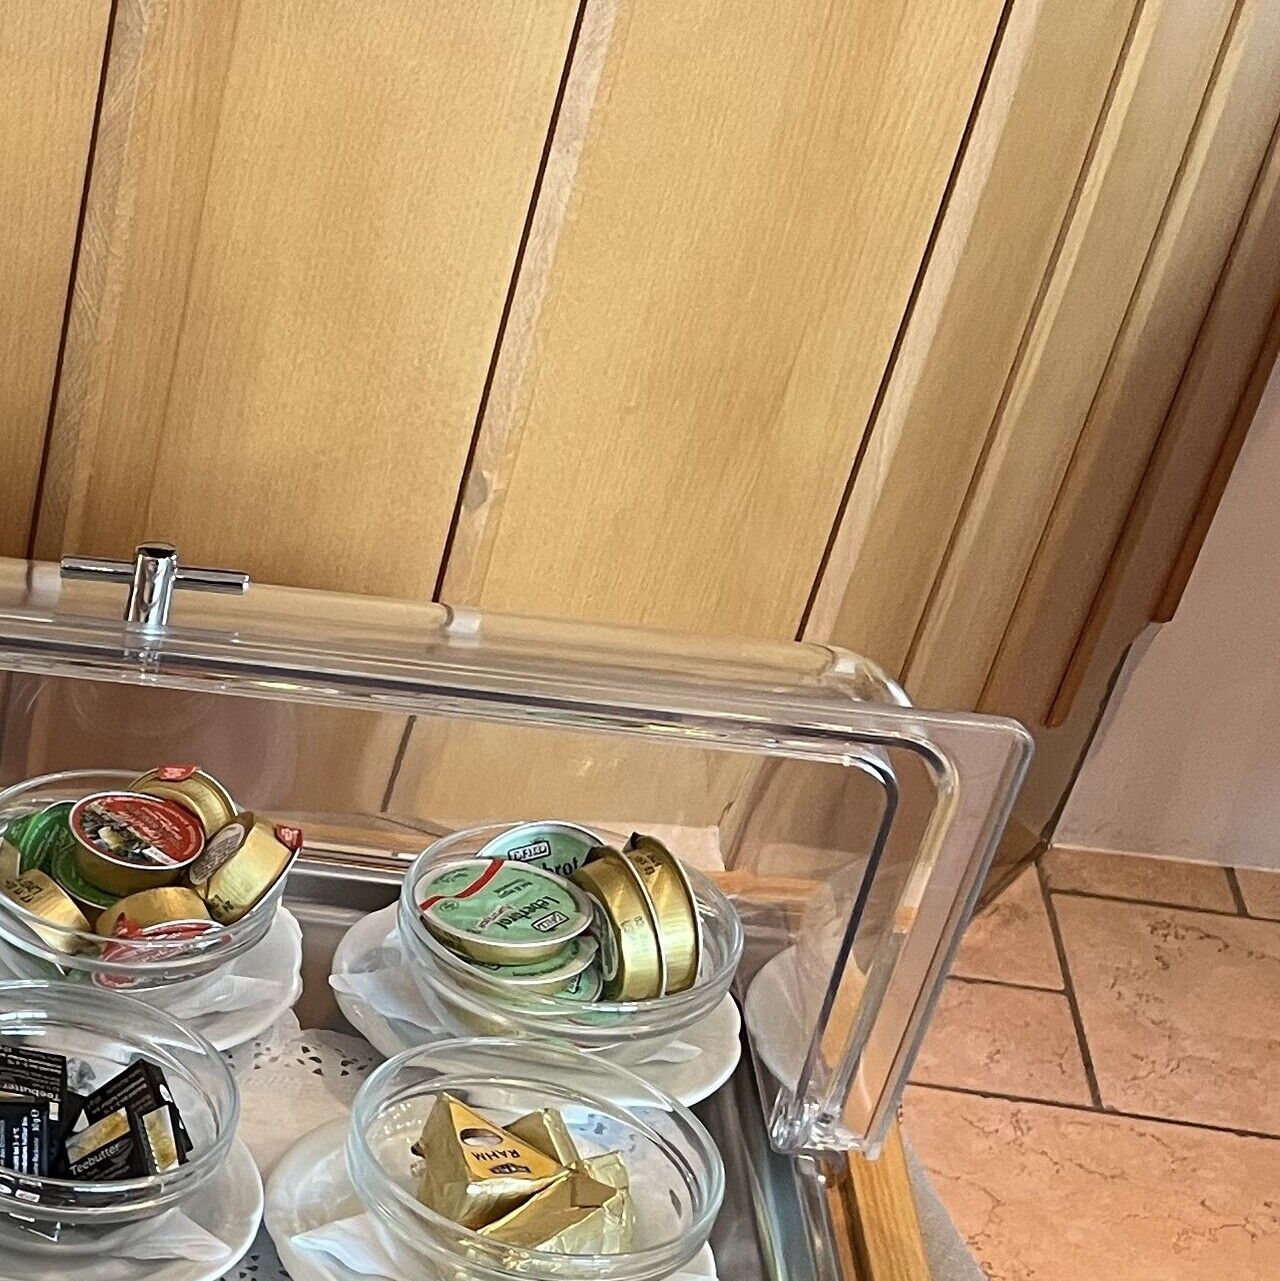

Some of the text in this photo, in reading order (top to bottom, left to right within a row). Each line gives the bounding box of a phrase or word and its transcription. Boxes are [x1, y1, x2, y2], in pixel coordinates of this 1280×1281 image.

[2, 1082, 61, 1102] Teebutter
[69, 1142, 121, 1176] Teebutter
[471, 1148, 521, 1162] RAHM
